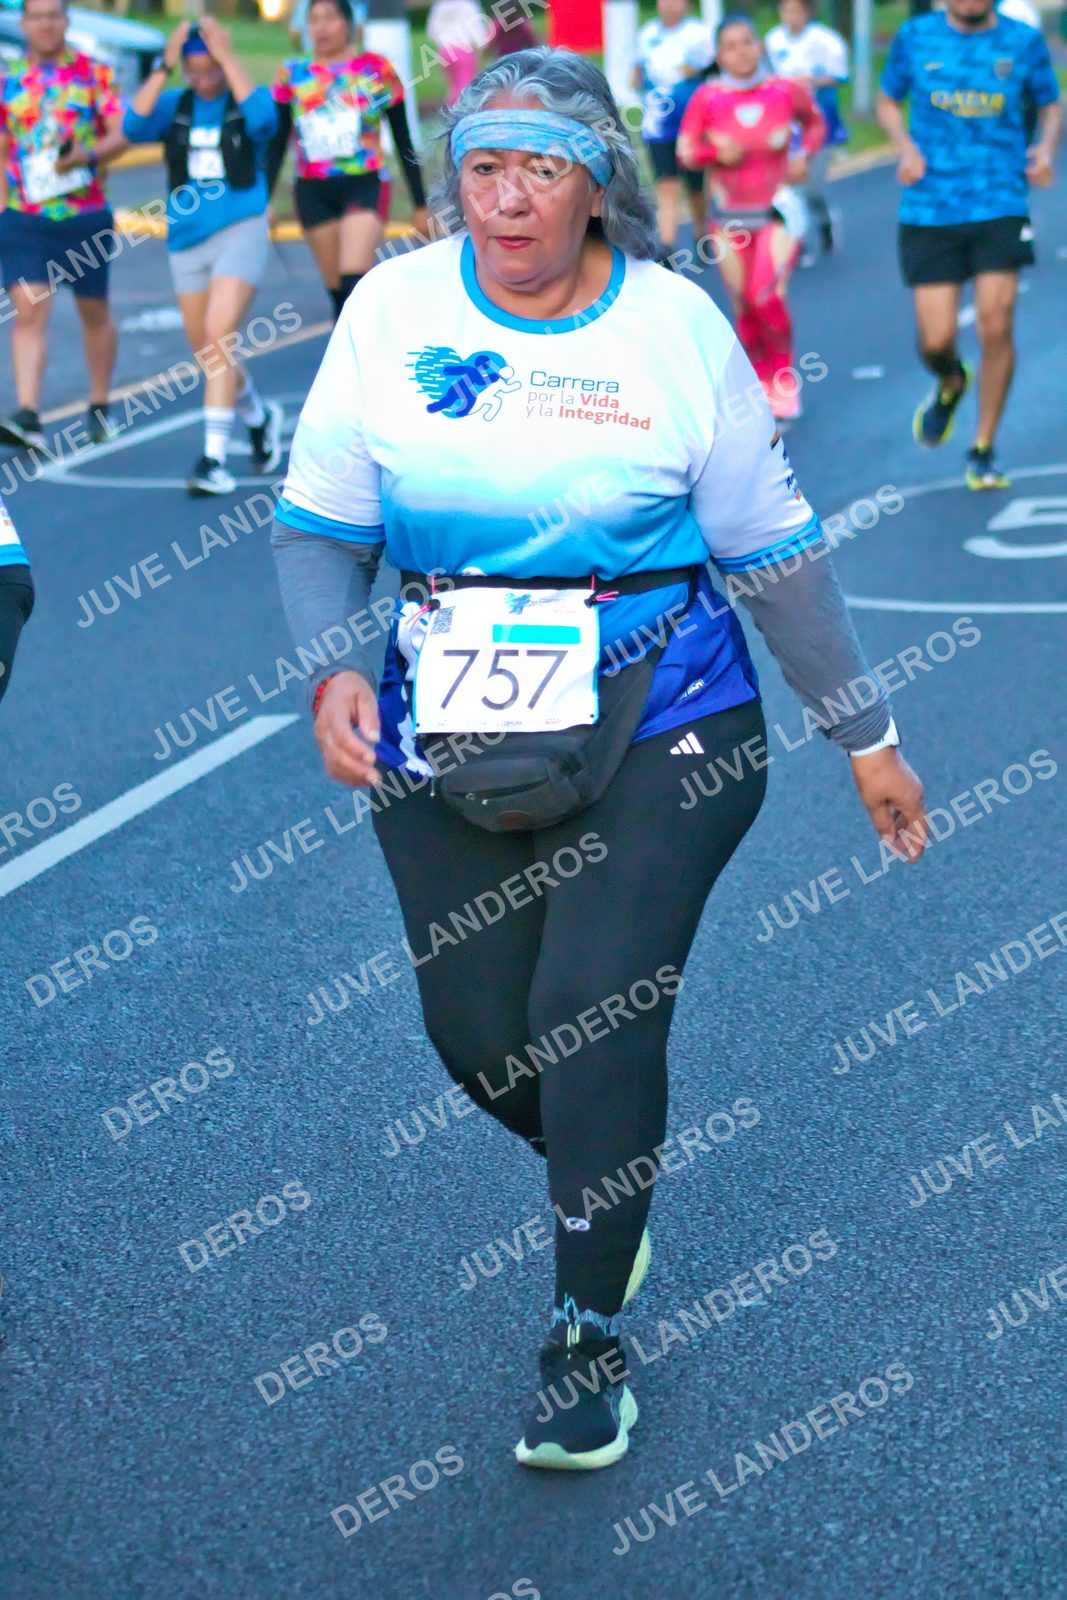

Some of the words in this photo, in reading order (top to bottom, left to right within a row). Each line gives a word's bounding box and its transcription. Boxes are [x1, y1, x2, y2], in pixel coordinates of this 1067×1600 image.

[530, 370, 620, 394] Carrera
[527, 391, 556, 404] por
[560, 390, 575, 405] la
[580, 393, 620, 409] Vida
[526, 405, 535, 418] y
[539, 403, 553, 417] la
[558, 405, 651, 431] Integridad
[440, 649, 569, 711] 757
